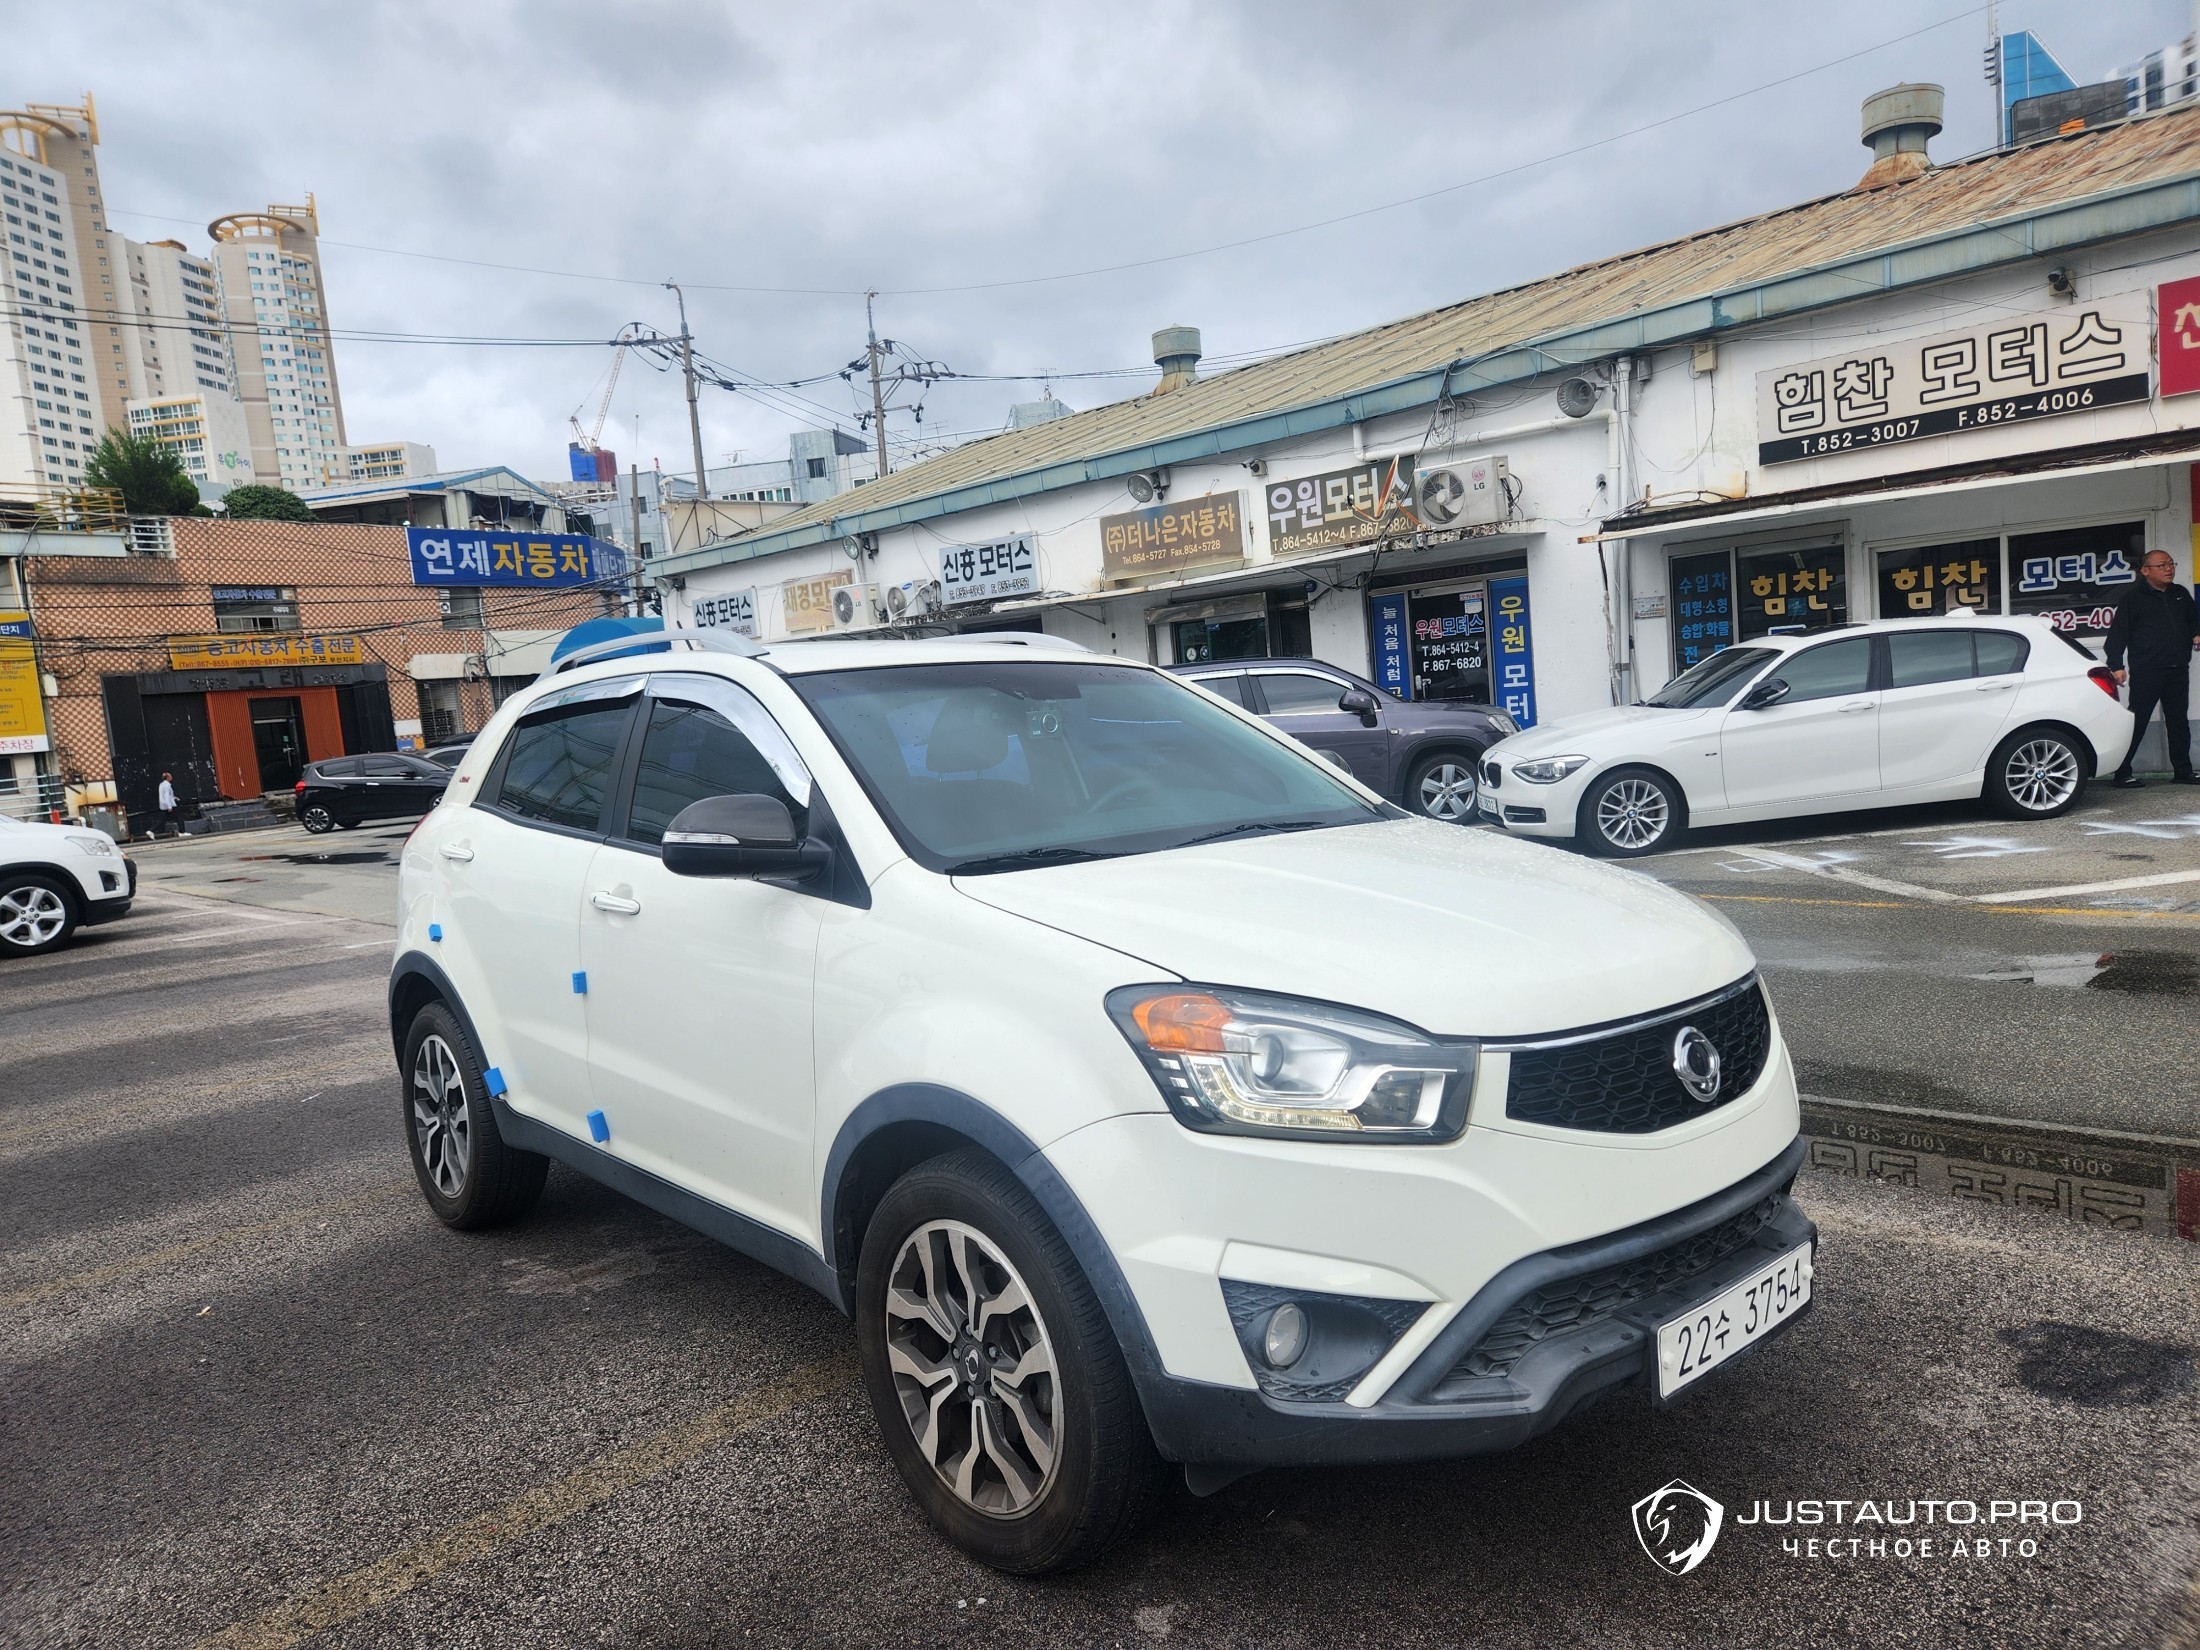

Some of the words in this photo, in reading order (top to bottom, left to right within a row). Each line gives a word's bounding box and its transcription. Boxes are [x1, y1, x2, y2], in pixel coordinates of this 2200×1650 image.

[1775, 356, 1893, 433] 힘찬
[1920, 311, 2125, 405] 모터스
[1801, 418, 1921, 456] T.852-3007
[1958, 388, 2095, 428] F.852-4006
[1474, 482, 1485, 491] LG
[1106, 502, 1235, 554] (주)더나은자동차
[1272, 530, 1346, 553] T.864-5412~4
[979, 540, 1033, 577] 모터스
[1122, 549, 1167, 565] Tel.864-5727
[1170, 539, 1221, 558] Fax.864-5728
[1679, 572, 1728, 595] 수입차
[1751, 568, 1833, 616] 힘찬
[1892, 560, 1988, 610] 힘찬
[2019, 550, 2136, 593] 모터스
[718, 595, 753, 624] 모터스
[1382, 607, 1397, 620] 늘
[1415, 614, 1485, 640] 우원모터스
[1422, 641, 1480, 657] T.864-5412~4
[1423, 657, 1482, 672] F.867-6820
[1678, 1309, 1730, 1378] 22수
[1745, 1258, 1801, 1335] 3754
